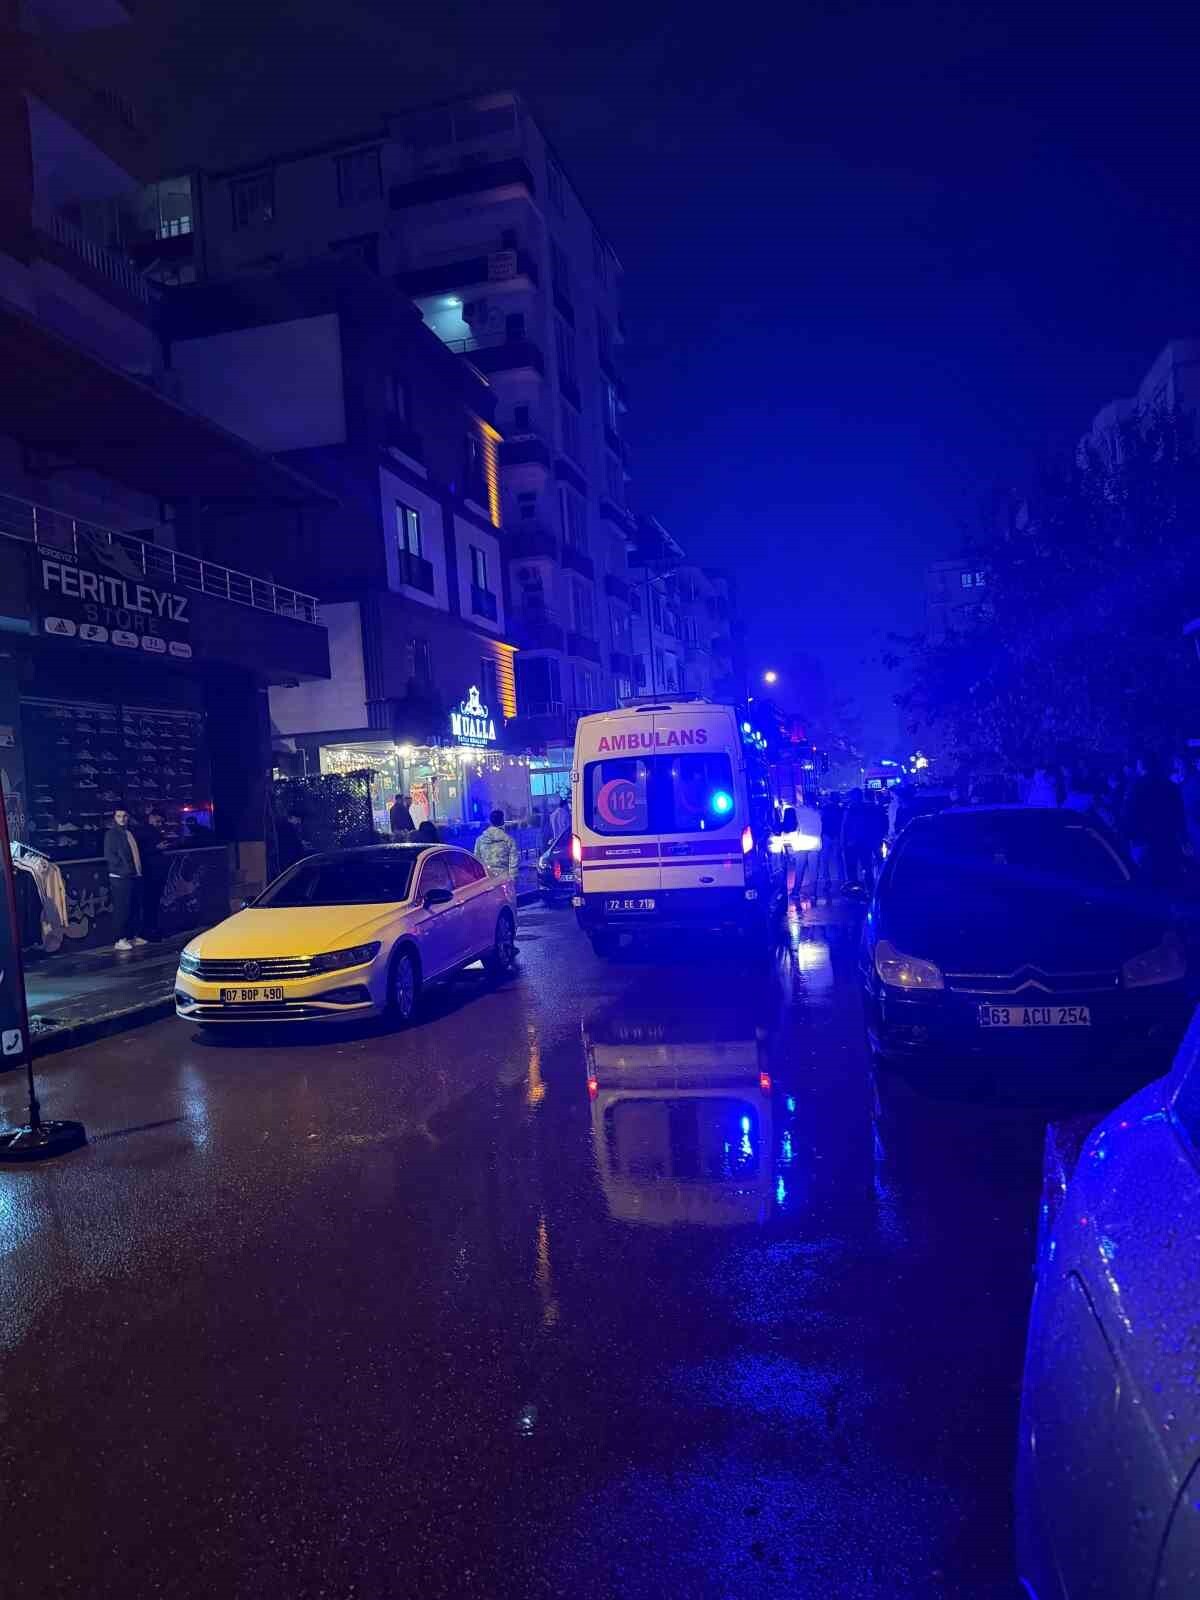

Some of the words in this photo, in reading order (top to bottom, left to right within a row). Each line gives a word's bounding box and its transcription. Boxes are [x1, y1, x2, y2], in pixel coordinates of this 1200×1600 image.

[86, 603, 161, 634] STORE
[451, 712, 496, 740] MUALLA
[598, 728, 708, 752] AMBULANS
[609, 791, 636, 810] 112
[609, 899, 620, 910] 72
[624, 899, 634, 910] EE
[226, 990, 237, 1001] 07
[991, 1008, 1010, 1025] 63
[1023, 1008, 1051, 1025] ACU
[1058, 1008, 1089, 1025] 254
